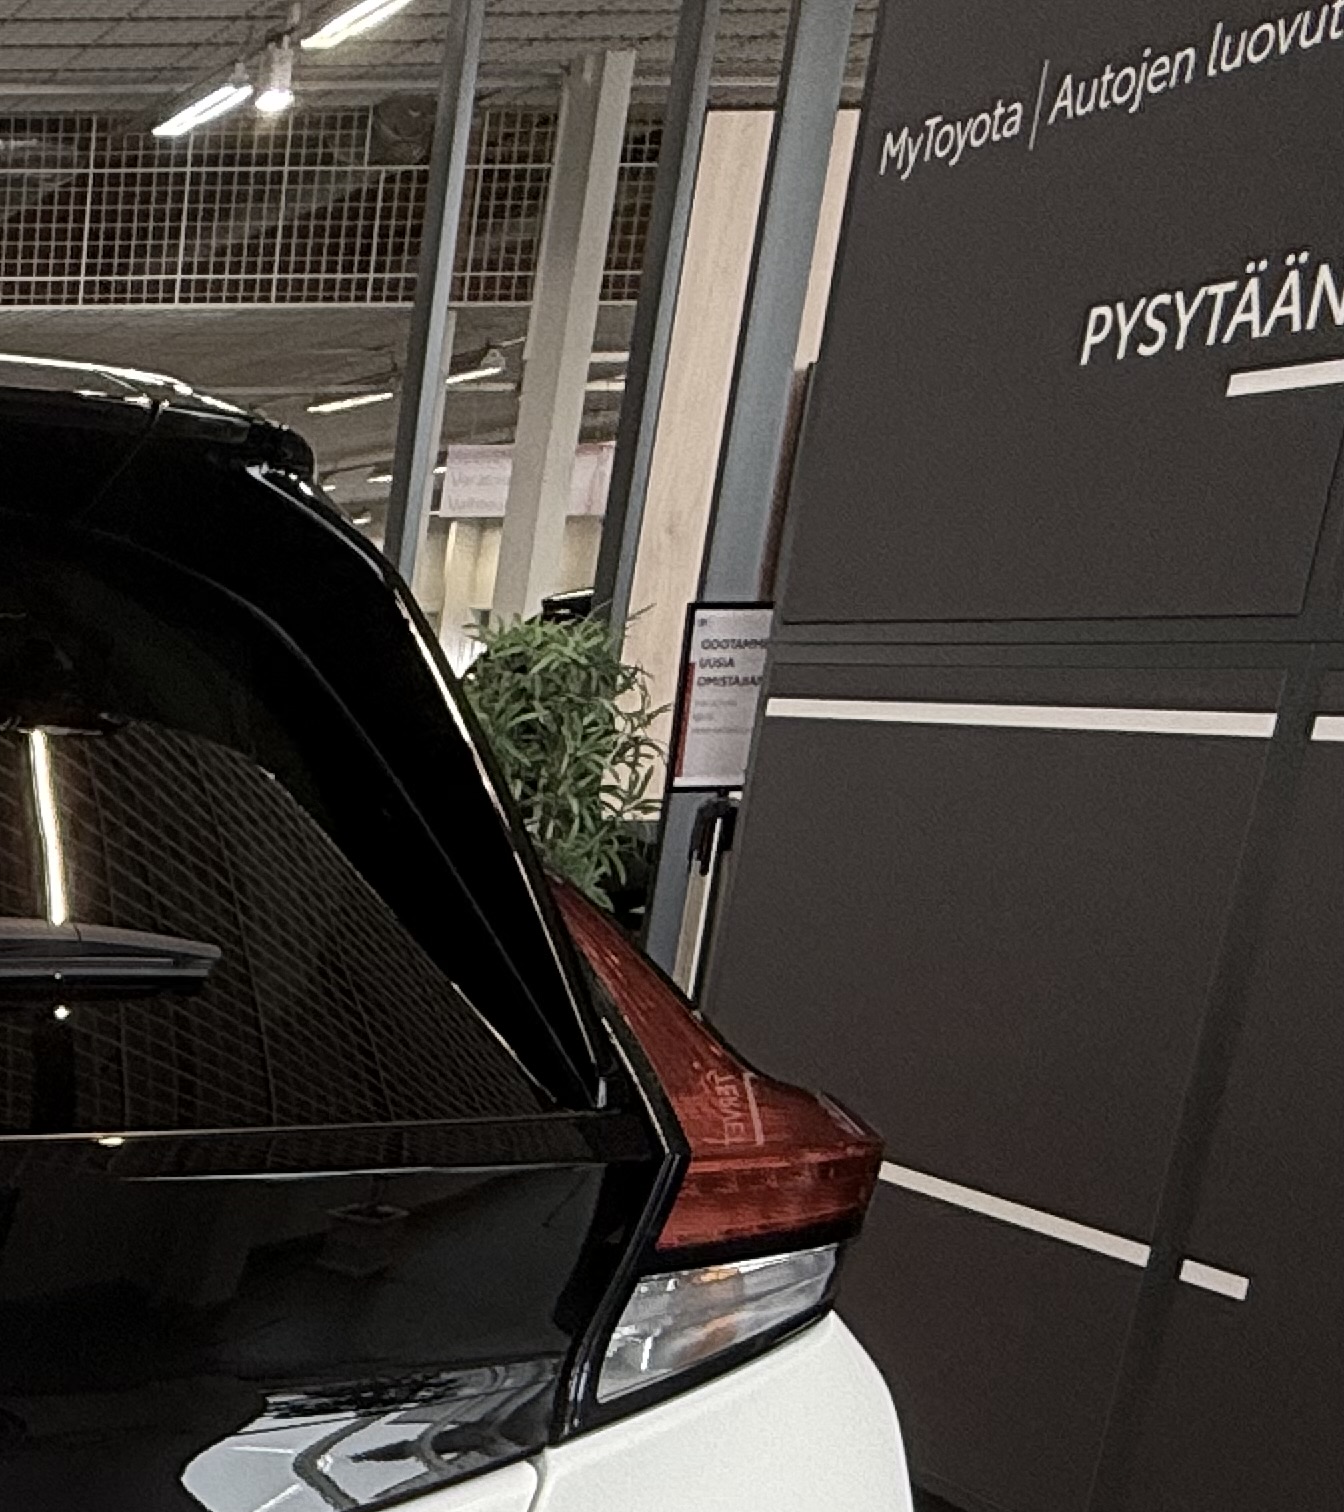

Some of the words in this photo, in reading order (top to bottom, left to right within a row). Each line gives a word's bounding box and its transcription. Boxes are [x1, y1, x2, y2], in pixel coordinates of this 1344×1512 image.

[879, 99, 1024, 181] MyToyota
[1047, 47, 1196, 125] Autojen
[1080, 250, 1344, 366] PYSYTÄÄN
